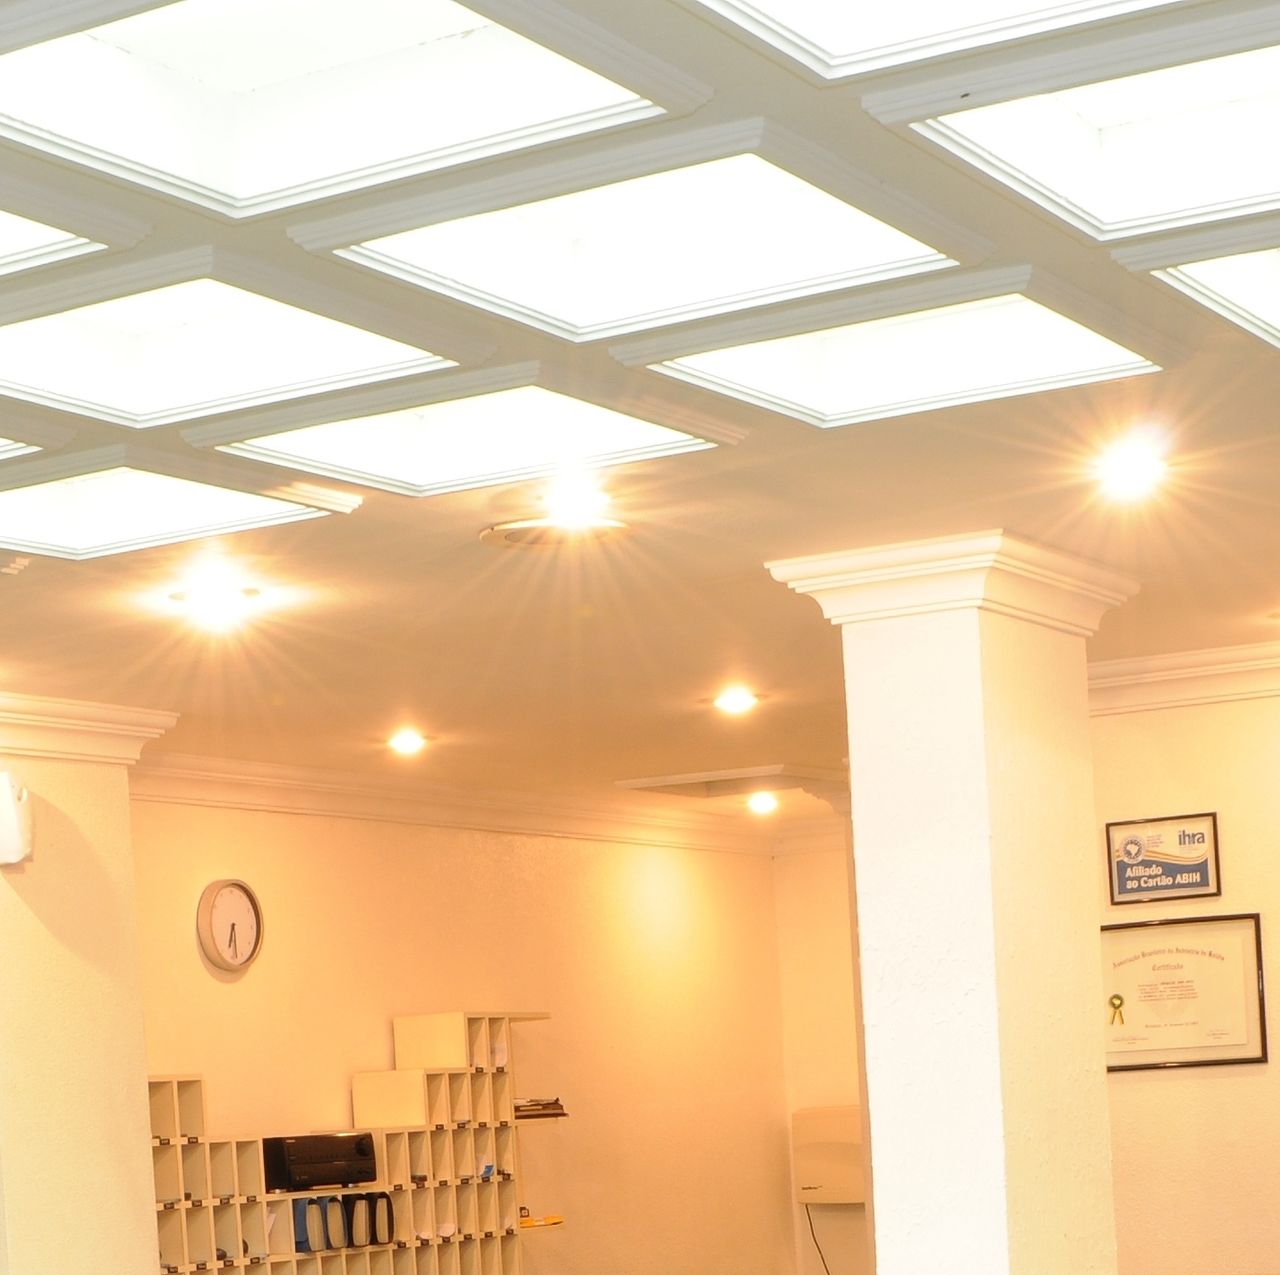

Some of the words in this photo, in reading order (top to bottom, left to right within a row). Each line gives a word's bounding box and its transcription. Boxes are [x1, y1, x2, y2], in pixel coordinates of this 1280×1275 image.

[1125, 864, 1163, 878] Afiliado
[1126, 880, 1139, 889] ao
[1140, 875, 1173, 888] Cartão
[1175, 871, 1201, 884] ABIH
